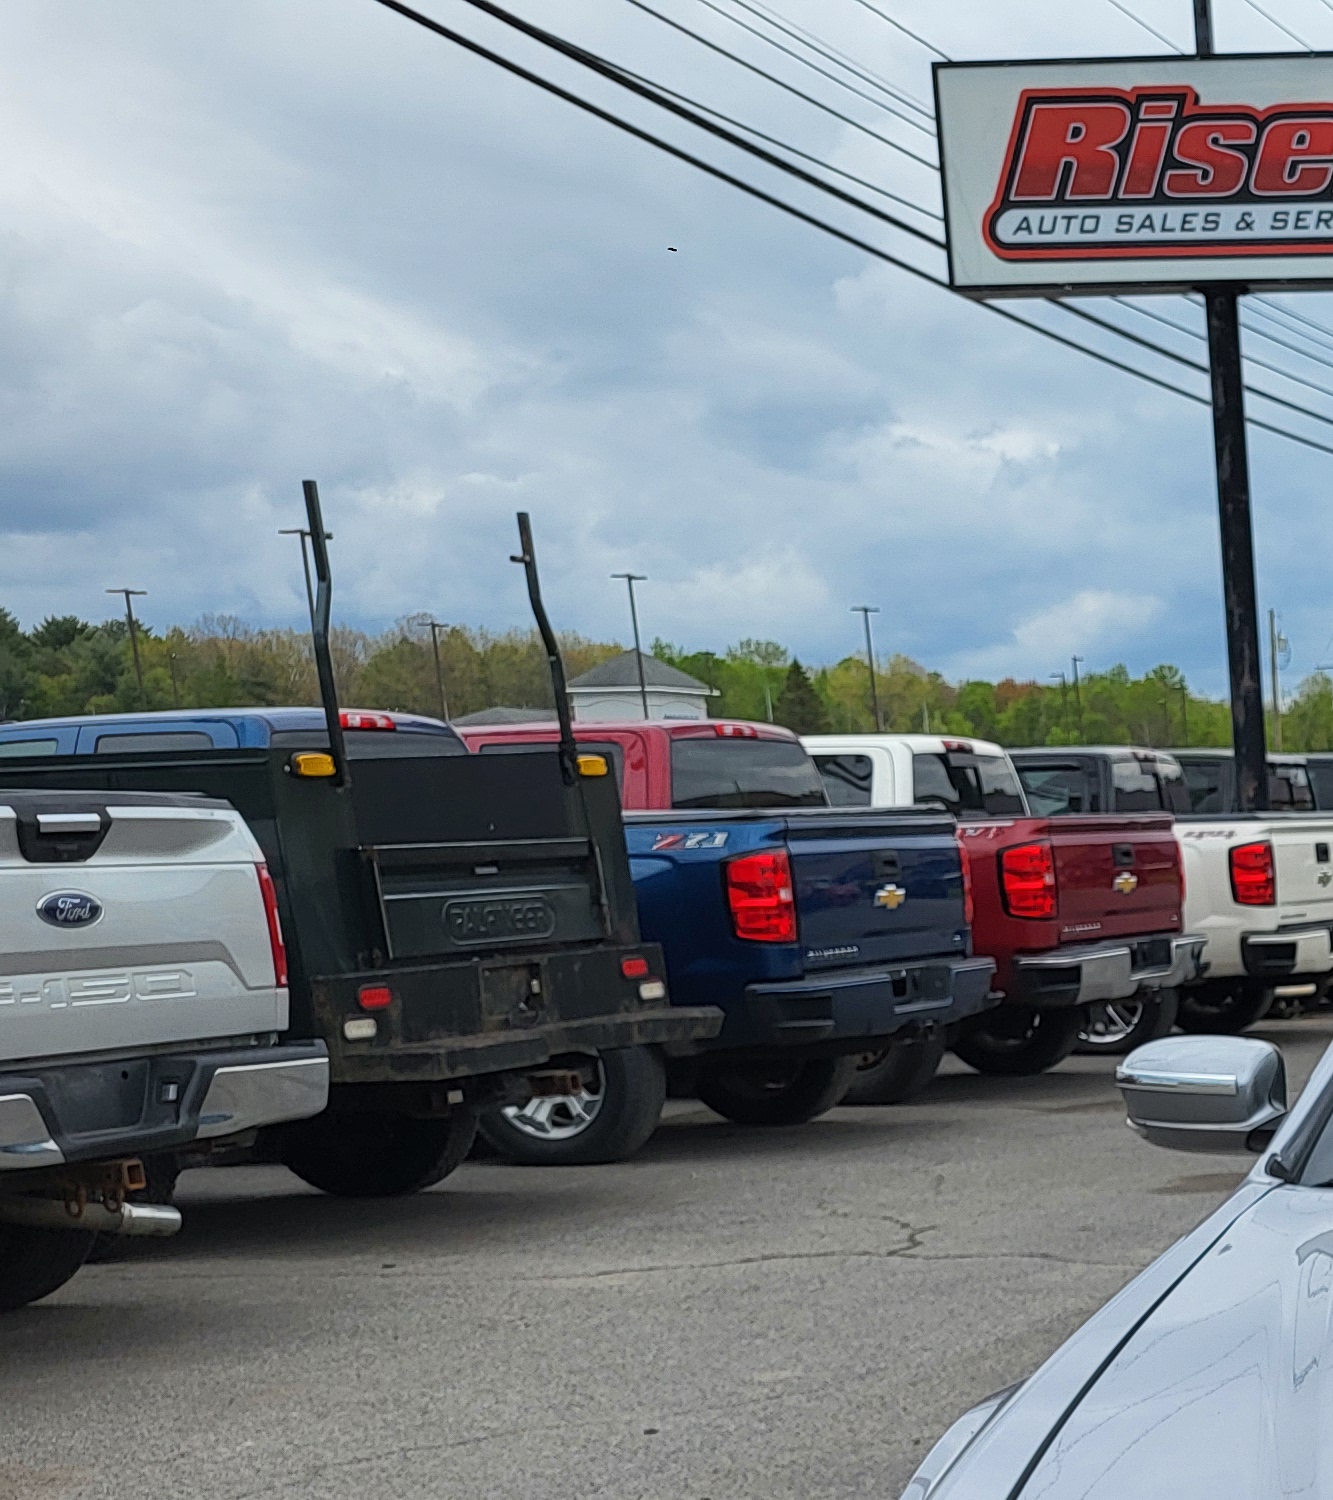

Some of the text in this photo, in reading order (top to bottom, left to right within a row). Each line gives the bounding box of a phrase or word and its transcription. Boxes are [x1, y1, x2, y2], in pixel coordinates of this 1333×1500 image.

[1012, 213, 1101, 237] AUTO
[1114, 211, 1222, 234] SALES
[1235, 211, 1256, 232] &
[651, 831, 729, 851] Z71
[55, 897, 92, 922] Ford
[0, 968, 198, 1009] -150
